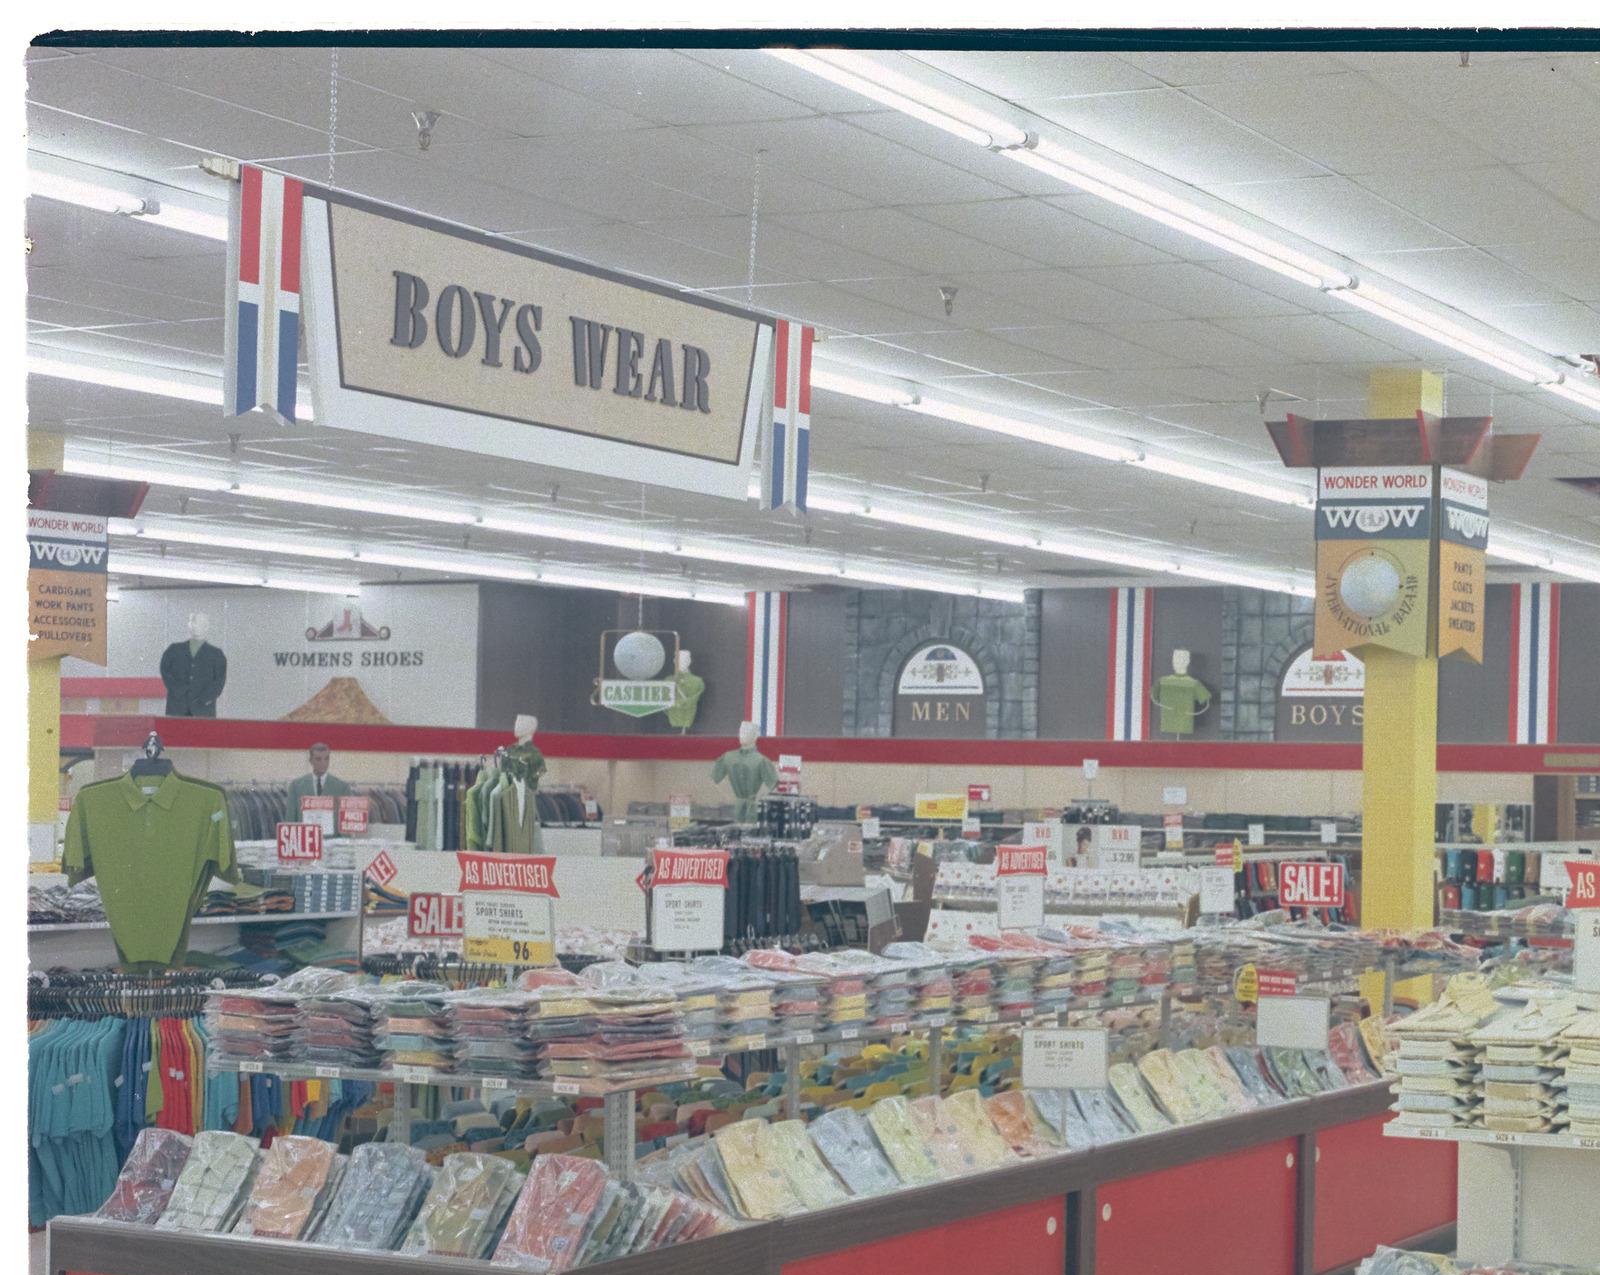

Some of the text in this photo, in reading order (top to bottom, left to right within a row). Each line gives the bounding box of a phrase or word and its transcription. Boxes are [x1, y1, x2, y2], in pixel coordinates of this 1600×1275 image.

[390, 270, 711, 414] BOYS WEAR
[1324, 475, 1427, 489] WONDER WORLD
[28, 517, 104, 534] WONDER WORLD
[1321, 504, 1425, 533] WOW
[30, 541, 106, 566] WOW
[1453, 561, 1472, 576] PANTS
[38, 585, 92, 597] CARDIGANS
[1452, 580, 1473, 595] COATS
[35, 600, 94, 612] WORK PANTS
[1325, 574, 1418, 637] INTERNATIONAL BAZAAR
[1450, 600, 1475, 615] JACKETS
[33, 615, 96, 628] ACCESSORIES
[1448, 617, 1476, 633] SWEATERS
[39, 630, 93, 641] PULLOVERS
[273, 651, 424, 667] WOMENS SHOES
[603, 685, 671, 702] CASHIER
[911, 701, 971, 721] MEN
[1290, 704, 1364, 726] BOYS
[280, 825, 320, 858] SALE!
[465, 860, 549, 888] AS ADVERTISED
[658, 857, 724, 880] AS ADVERTISED
[1284, 865, 1339, 902] SALE!
[1576, 871, 1596, 899] AS
[475, 907, 524, 919] SPORT SHIRTS
[513, 941, 530, 960] 96
[1034, 1040, 1084, 1049] SPORT SHIRTS
